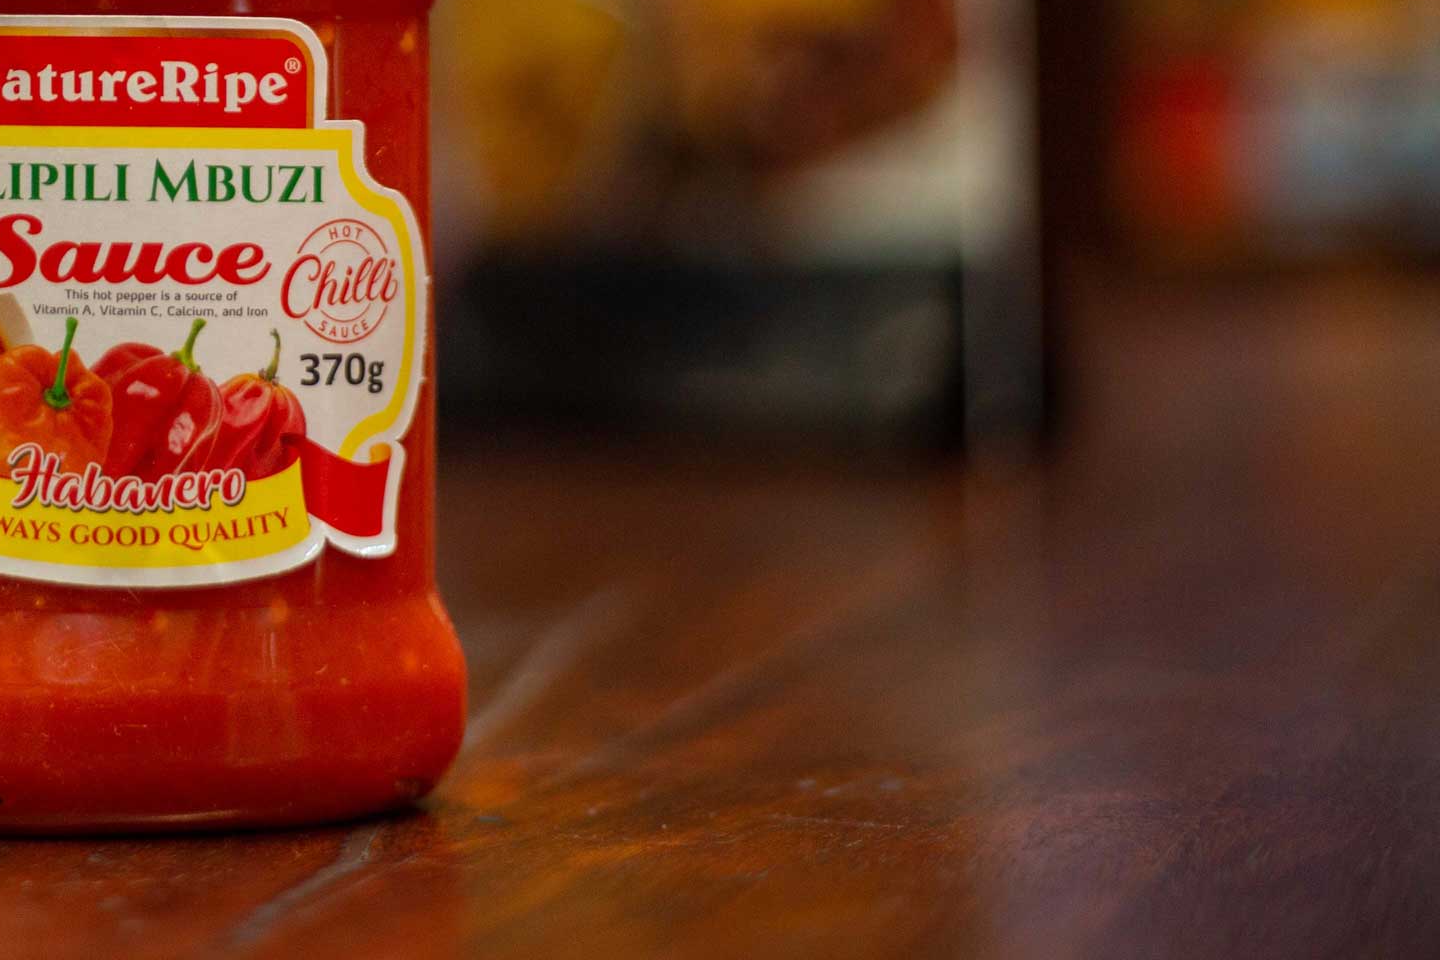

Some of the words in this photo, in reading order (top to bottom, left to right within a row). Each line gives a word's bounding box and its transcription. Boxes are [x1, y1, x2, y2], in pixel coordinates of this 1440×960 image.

[148, 157, 326, 204] MBUZI
[328, 225, 364, 240] HOT
[64, 289, 89, 301] This
[93, 290, 112, 301] hot
[116, 291, 156, 303] pepper
[160, 290, 170, 301] is
[174, 293, 182, 301] a
[185, 292, 223, 302] source
[226, 290, 239, 302] of
[280, 254, 398, 319] Chilli
[33, 304, 79, 316] Vitamin
[82, 304, 95, 317] A,
[100, 305, 147, 317] Vitamin
[150, 306, 162, 318] C,
[166, 306, 218, 318] Calcium,
[222, 307, 244, 318] and
[246, 307, 269, 318] Iron
[319, 319, 369, 338] SAUCE
[299, 352, 385, 394] 370g
[8, 443, 246, 513] Habanero
[69, 524, 160, 547] GOOD
[169, 506, 290, 551] QUALITY
